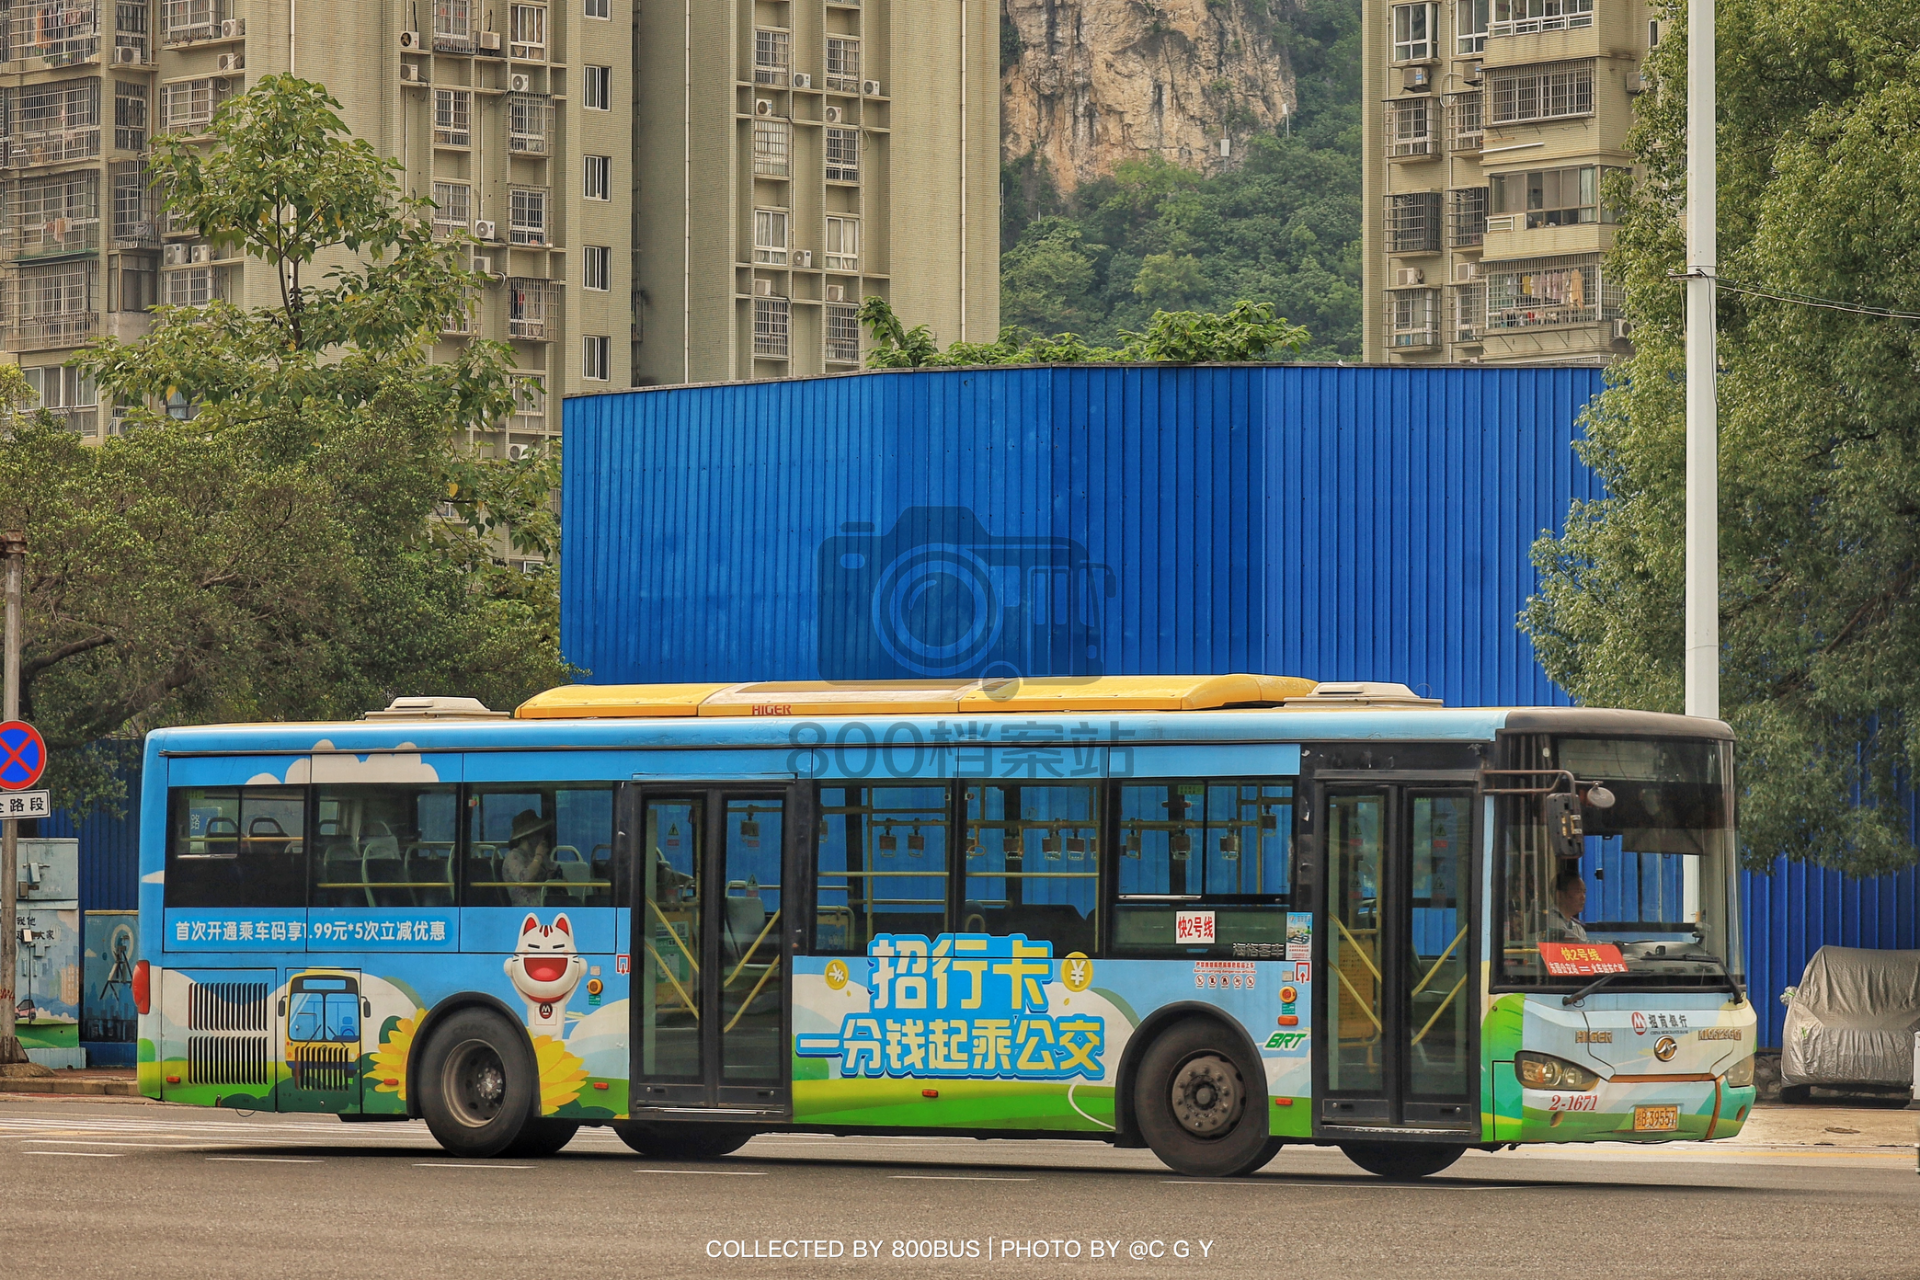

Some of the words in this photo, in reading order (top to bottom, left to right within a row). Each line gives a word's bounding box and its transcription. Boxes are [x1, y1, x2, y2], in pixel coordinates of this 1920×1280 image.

[752, 704, 792, 716] HIGER
[1178, 916, 1214, 938] 快2号线
[1233, 942, 1285, 958] 海格客车
[1560, 946, 1603, 962] 快2号线
[872, 939, 1049, 1010] 招行卡
[800, 1018, 1101, 1071] 一分钱起乘公交
[1265, 1033, 1308, 1049] BRT
[1548, 1094, 1598, 1111] 2-1671
